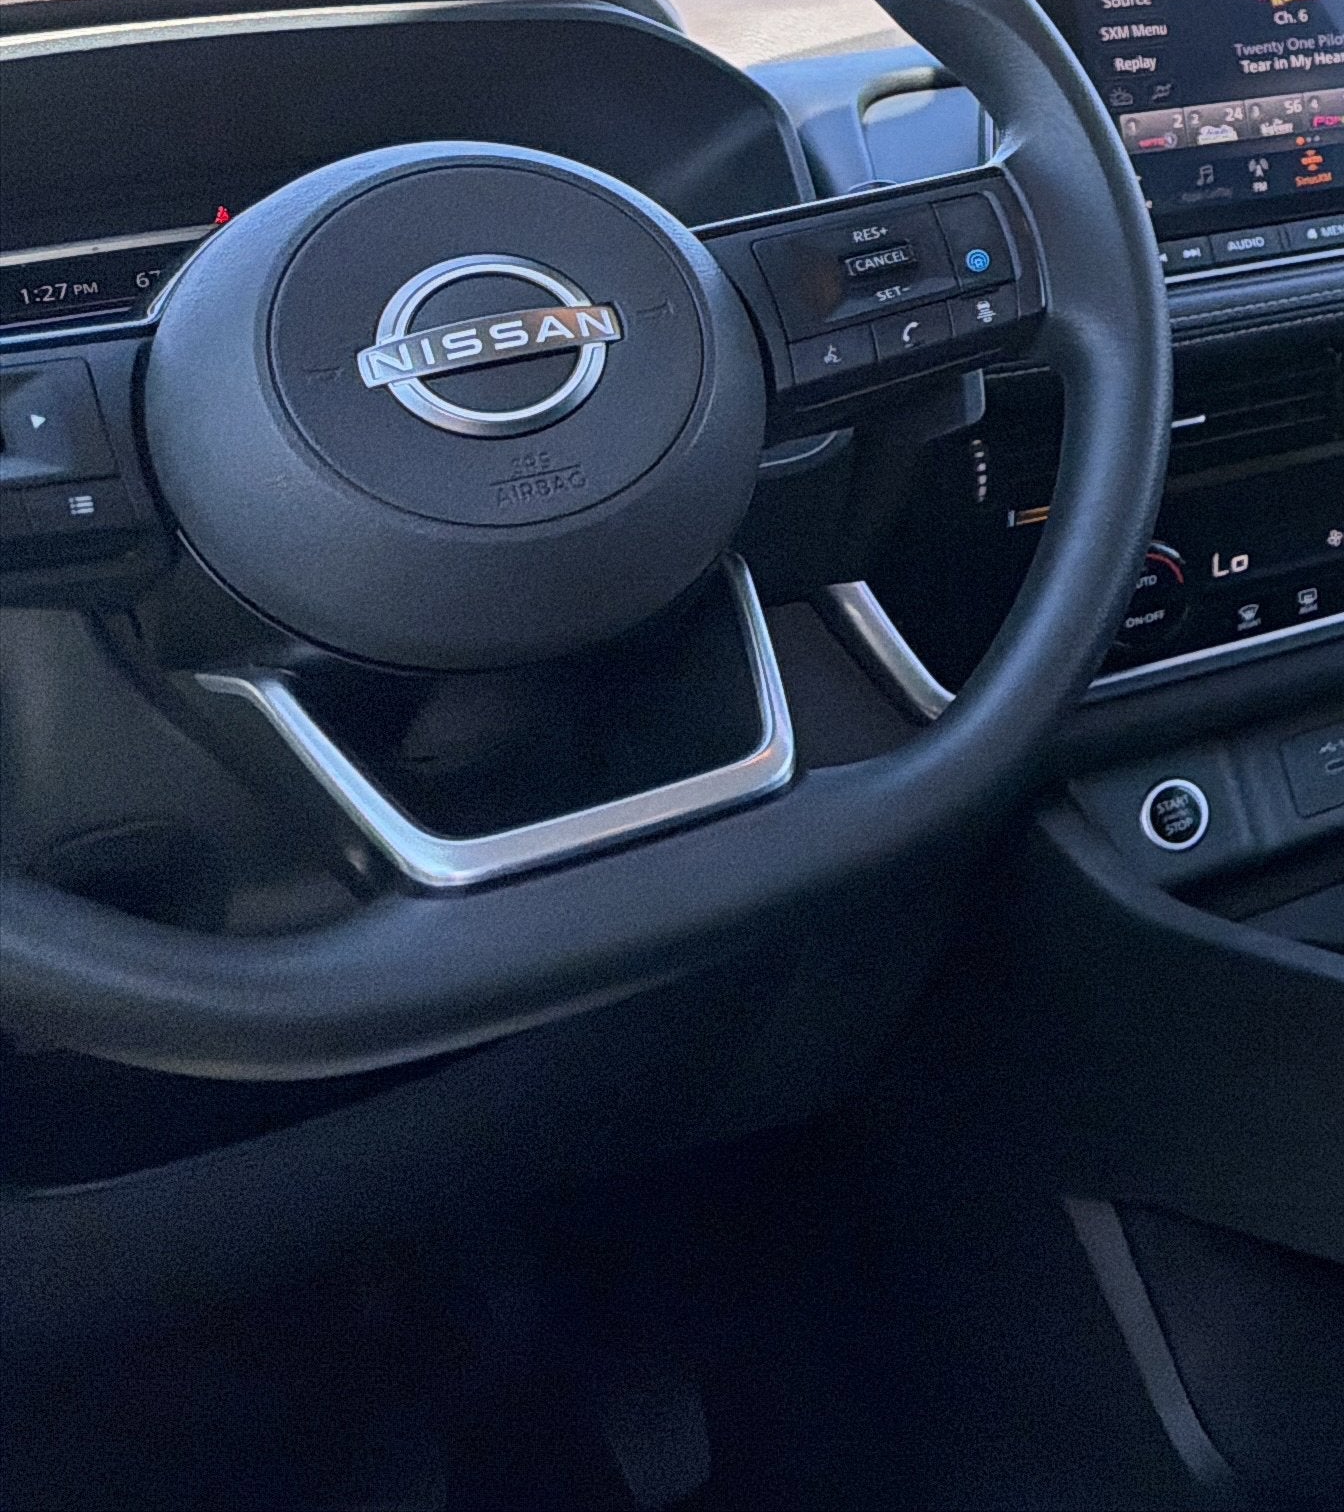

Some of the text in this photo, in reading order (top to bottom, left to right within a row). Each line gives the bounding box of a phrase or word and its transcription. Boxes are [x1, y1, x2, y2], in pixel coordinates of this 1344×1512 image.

[1274, 8, 1309, 25] Ch. 6
[1099, 24, 1167, 41] SXM Menu
[1233, 41, 1284, 56] Twenty
[1286, 37, 1315, 51] One
[1113, 55, 1157, 72] Replay
[1240, 59, 1272, 73] Tear
[1273, 57, 1289, 70] in
[1289, 55, 1312, 70] My
[1226, 107, 1243, 122] 24
[1284, 100, 1302, 115] 56
[1173, 114, 1183, 128] 2
[1227, 236, 1265, 251] AUDIO
[855, 249, 909, 272] CANCEL
[20, 282, 67, 305] 1:27
[73, 281, 99, 296] PM
[367, 309, 618, 380] NISSAN
[1212, 551, 1250, 578] Lo
[1156, 794, 1189, 815] START
[1164, 816, 1194, 837] STOP
